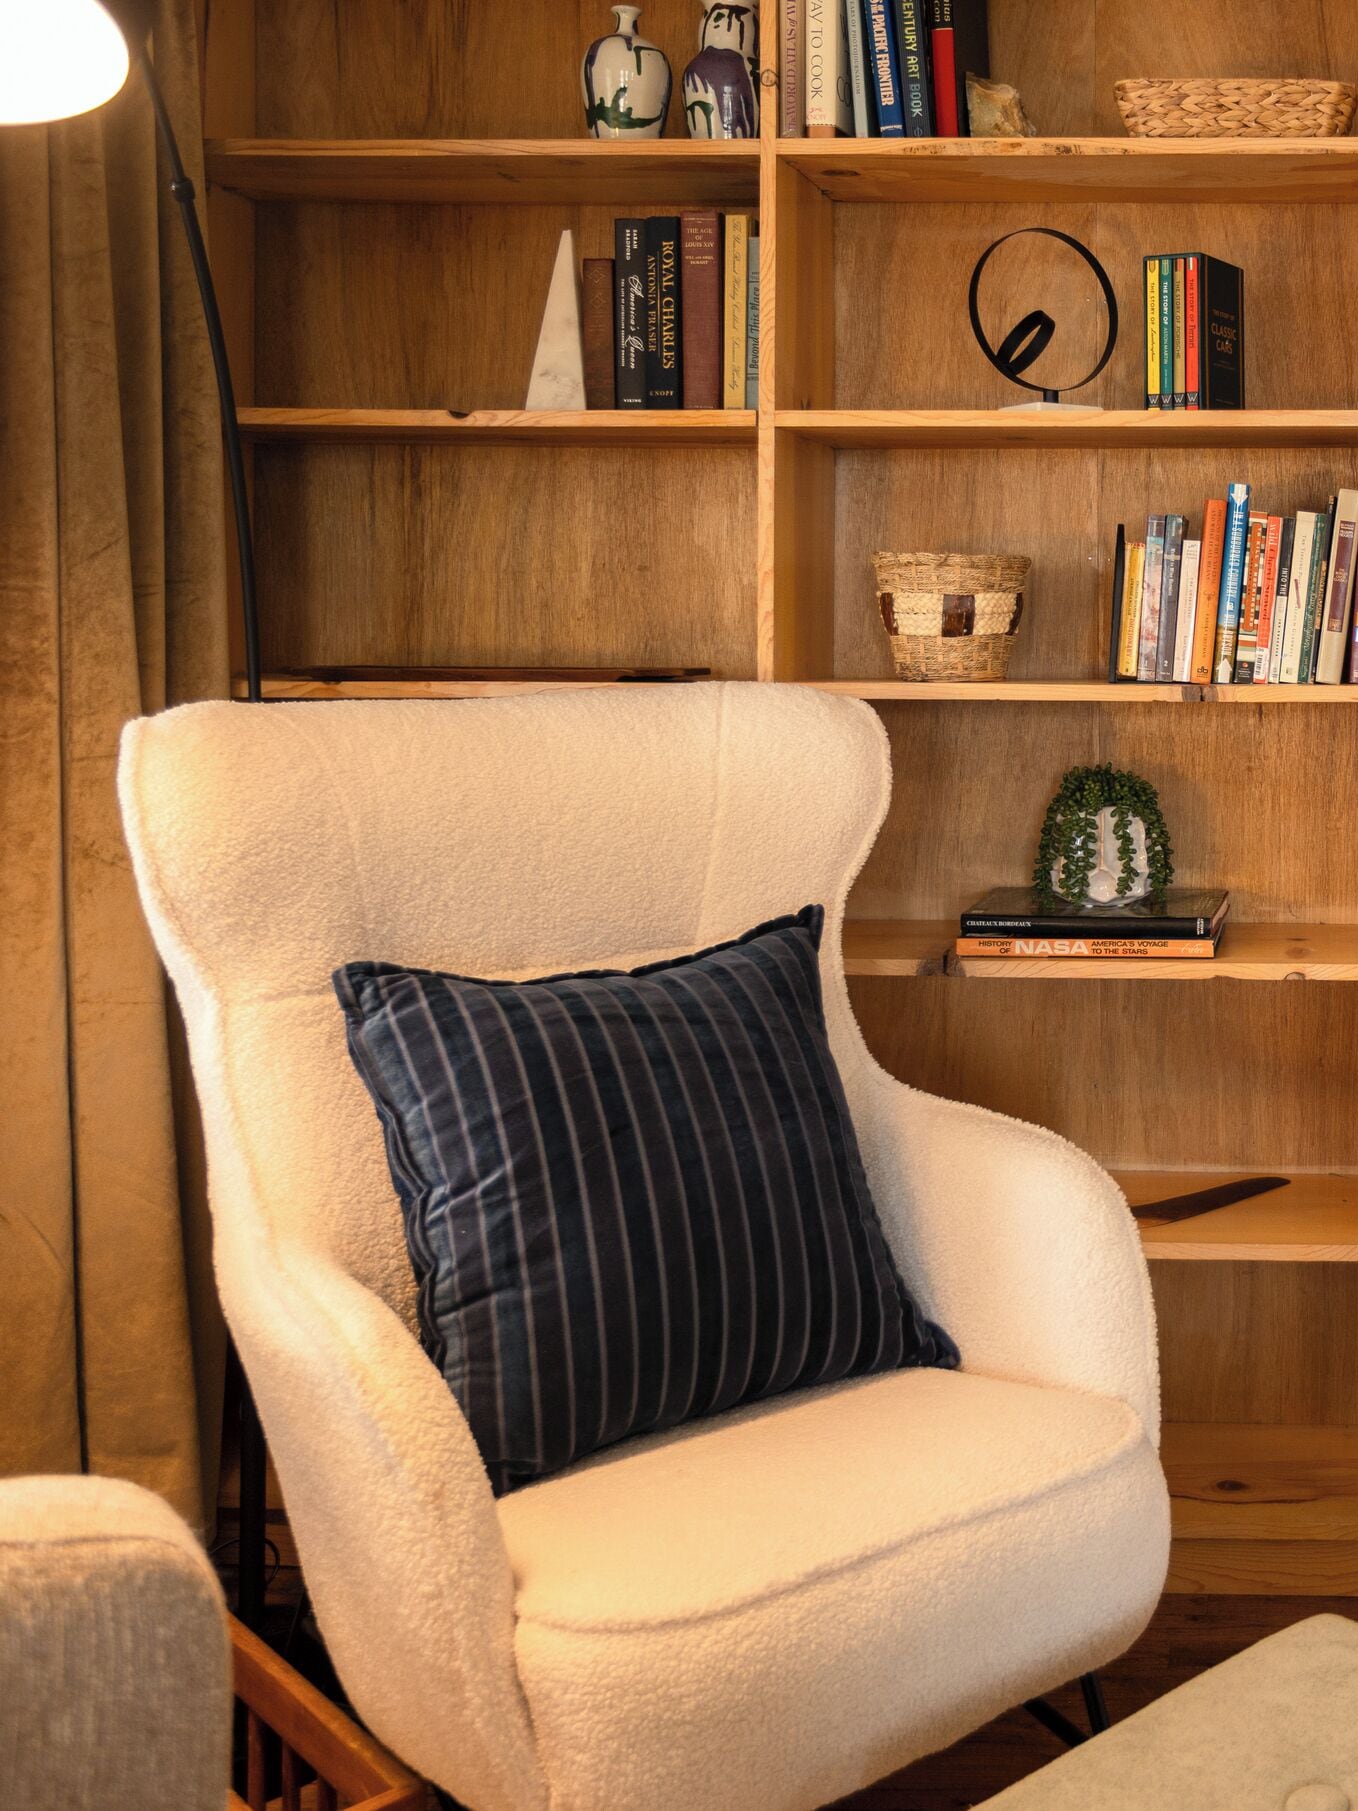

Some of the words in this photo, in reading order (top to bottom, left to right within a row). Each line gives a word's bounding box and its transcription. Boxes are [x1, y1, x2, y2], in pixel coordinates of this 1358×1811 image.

[811, 28, 823, 49] TO
[872, 15, 889, 53] PACIFIC
[901, 0, 918, 52] ENTURY
[786, 28, 796, 68] ATLAS
[810, 54, 823, 100] COOK
[876, 53, 895, 106] FRONTIER
[906, 56, 920, 80] ART
[786, 68, 796, 115] WORLD
[908, 83, 923, 118] BOOK
[647, 254, 657, 306] ANTONIA
[661, 240, 675, 292] ROYAL
[628, 275, 645, 332] America's
[1188, 314, 1195, 322] OF
[647, 310, 658, 353] FRASER
[661, 296, 676, 370] CHARLES
[748, 312, 760, 334] This
[1150, 317, 1157, 326] OF
[1162, 317, 1169, 326] OF
[1175, 315, 1182, 324] OF
[1210, 322, 1237, 341] CLASSIC
[624, 335, 645, 369] Queen
[748, 336, 760, 370] Beyond
[1215, 339, 1233, 355] CARS
[1232, 510, 1243, 519] IN
[1229, 526, 1241, 566] SUNBURNED
[1256, 527, 1262, 537] TO
[1269, 522, 1280, 546] wild
[1253, 540, 1261, 559] KILL
[1266, 547, 1277, 582] Cheryl
[1280, 566, 1289, 583] INTO
[1226, 567, 1238, 598] COUNTRY
[1278, 583, 1287, 596] THE
[1247, 571, 1258, 627] MOCKINGBIRD
[1262, 583, 1274, 621] Strayed
[1224, 613, 1235, 626] BILL
[1125, 615, 1135, 657] DICTIONARY
[1222, 629, 1233, 656] BRYSON
[966, 920, 997, 928] CHATEAUX
[998, 920, 1031, 928] BORDEAUX
[1014, 940, 1089, 955] NASA
[1091, 941, 1133, 949] AMERICA'S
[1136, 941, 1169, 949] VOYAGE
